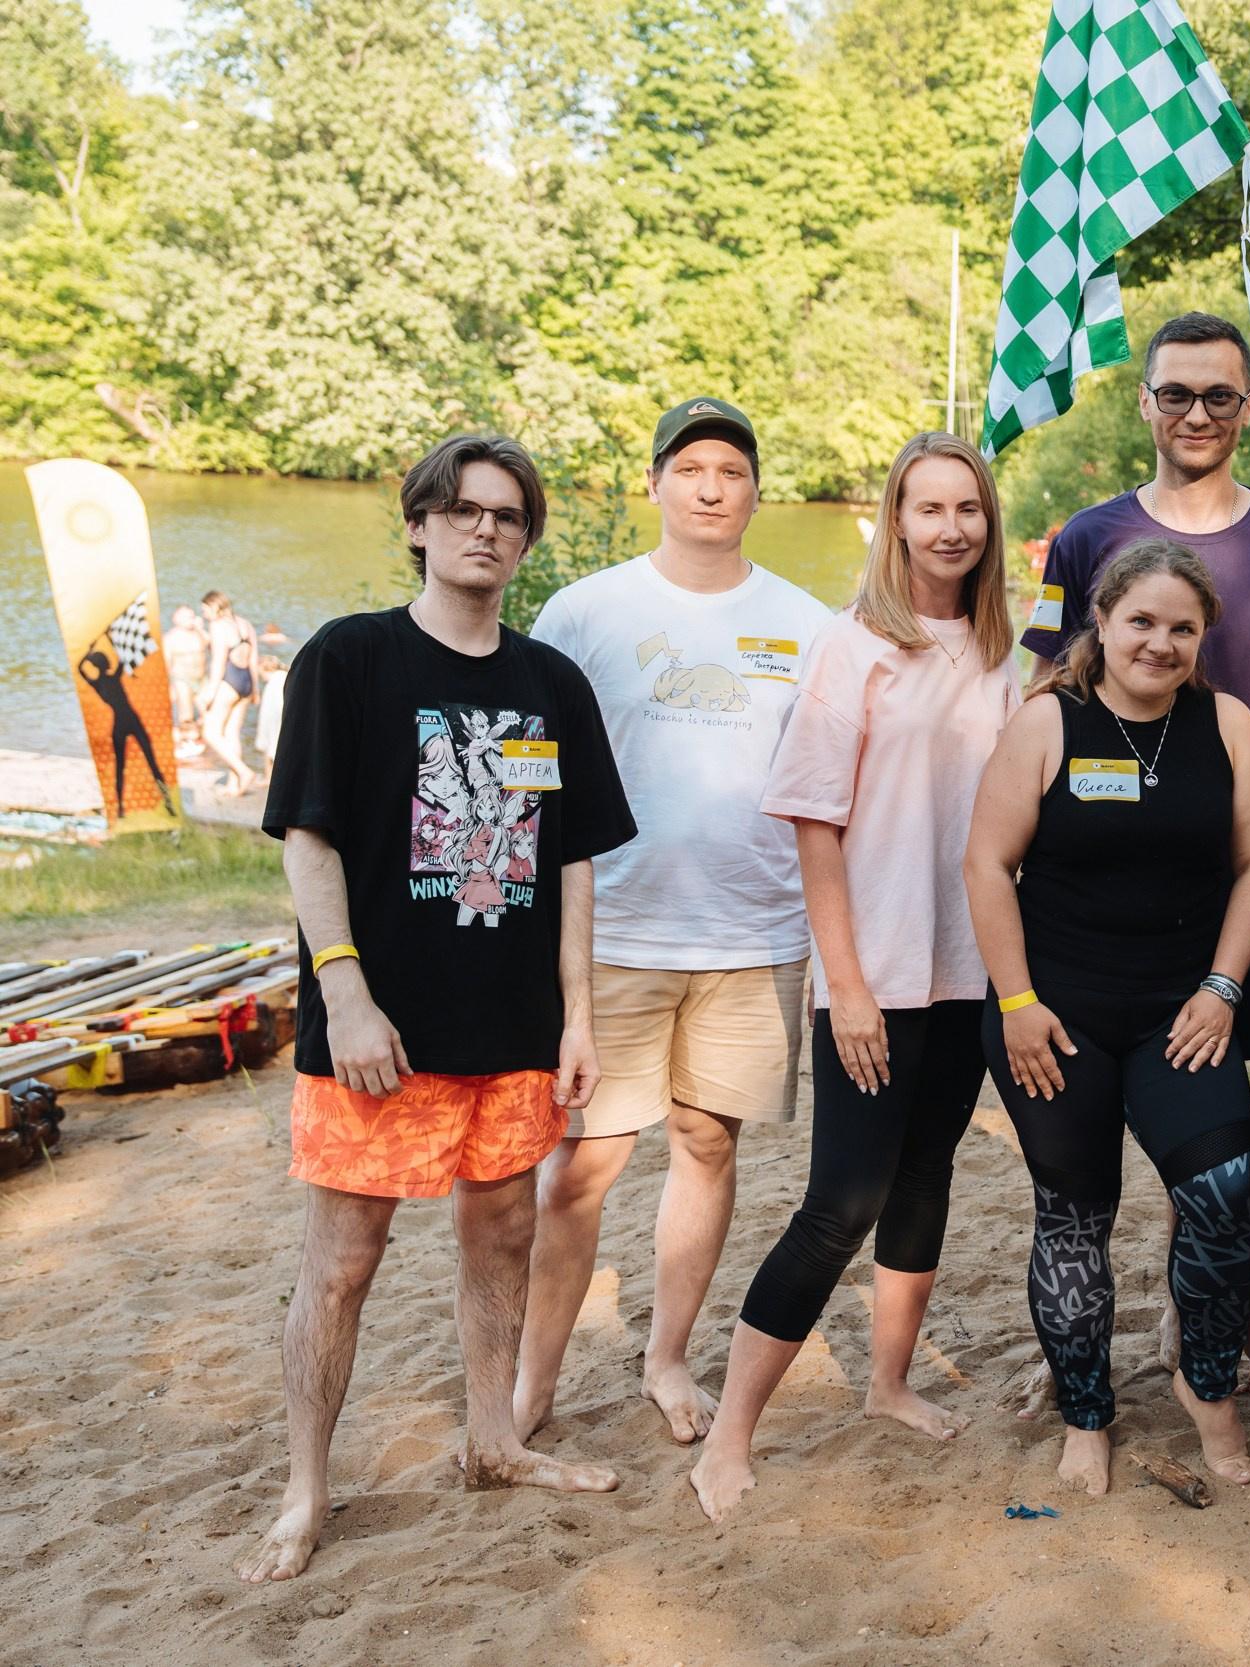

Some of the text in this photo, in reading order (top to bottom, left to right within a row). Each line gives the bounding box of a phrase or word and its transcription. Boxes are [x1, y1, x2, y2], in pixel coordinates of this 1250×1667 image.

[416, 716, 438, 724] FLORA
[500, 714, 519, 722] STELLA
[643, 710, 752, 731] Pikachu is recharging
[1076, 778, 1127, 793] Олеся
[501, 881, 534, 908] CLUB
[487, 904, 506, 914] BLOOM
